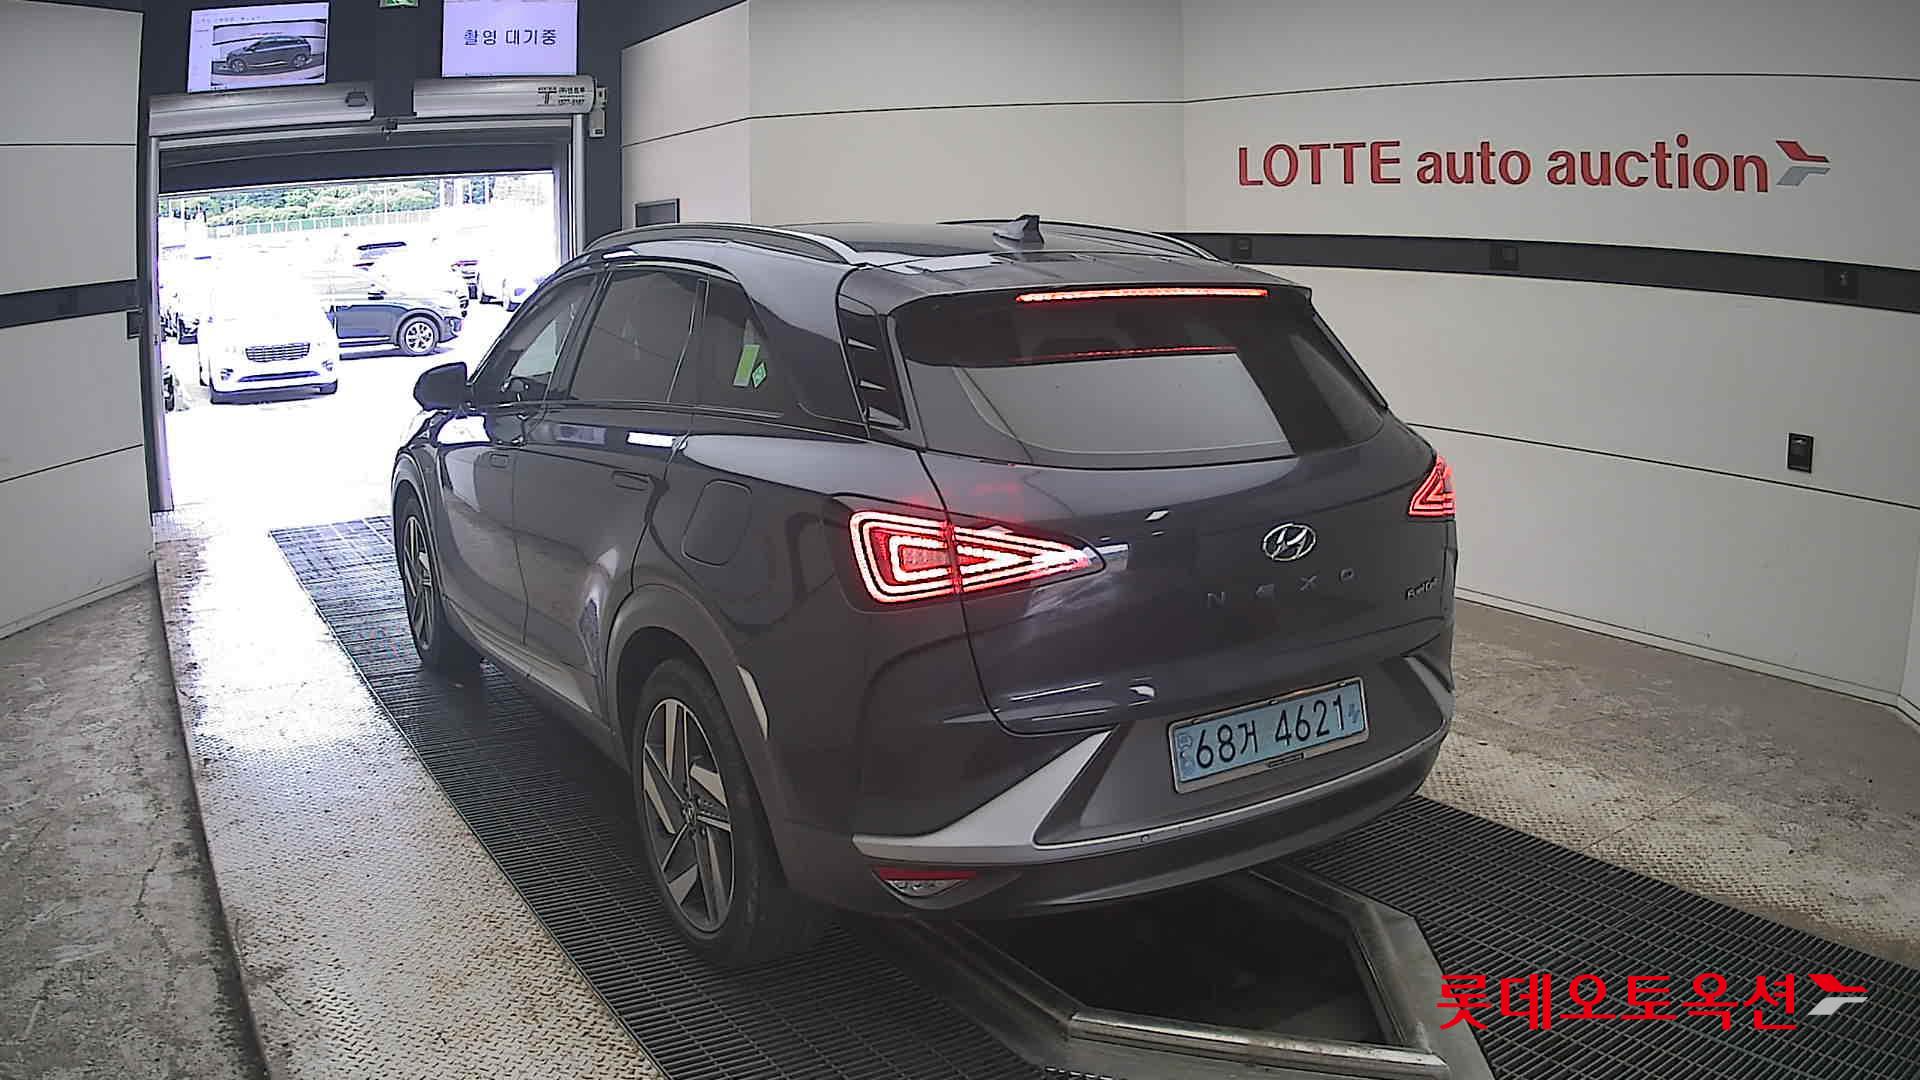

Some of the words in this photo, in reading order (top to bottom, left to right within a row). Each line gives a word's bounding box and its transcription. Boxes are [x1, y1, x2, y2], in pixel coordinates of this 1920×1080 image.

[505, 29, 557, 46] 대기중
[1238, 140, 1401, 187] LOTTE
[1416, 141, 1531, 186] auto
[1546, 133, 1769, 193] auction
[1196, 719, 1258, 769] 68거
[1275, 694, 1345, 747] 4621
